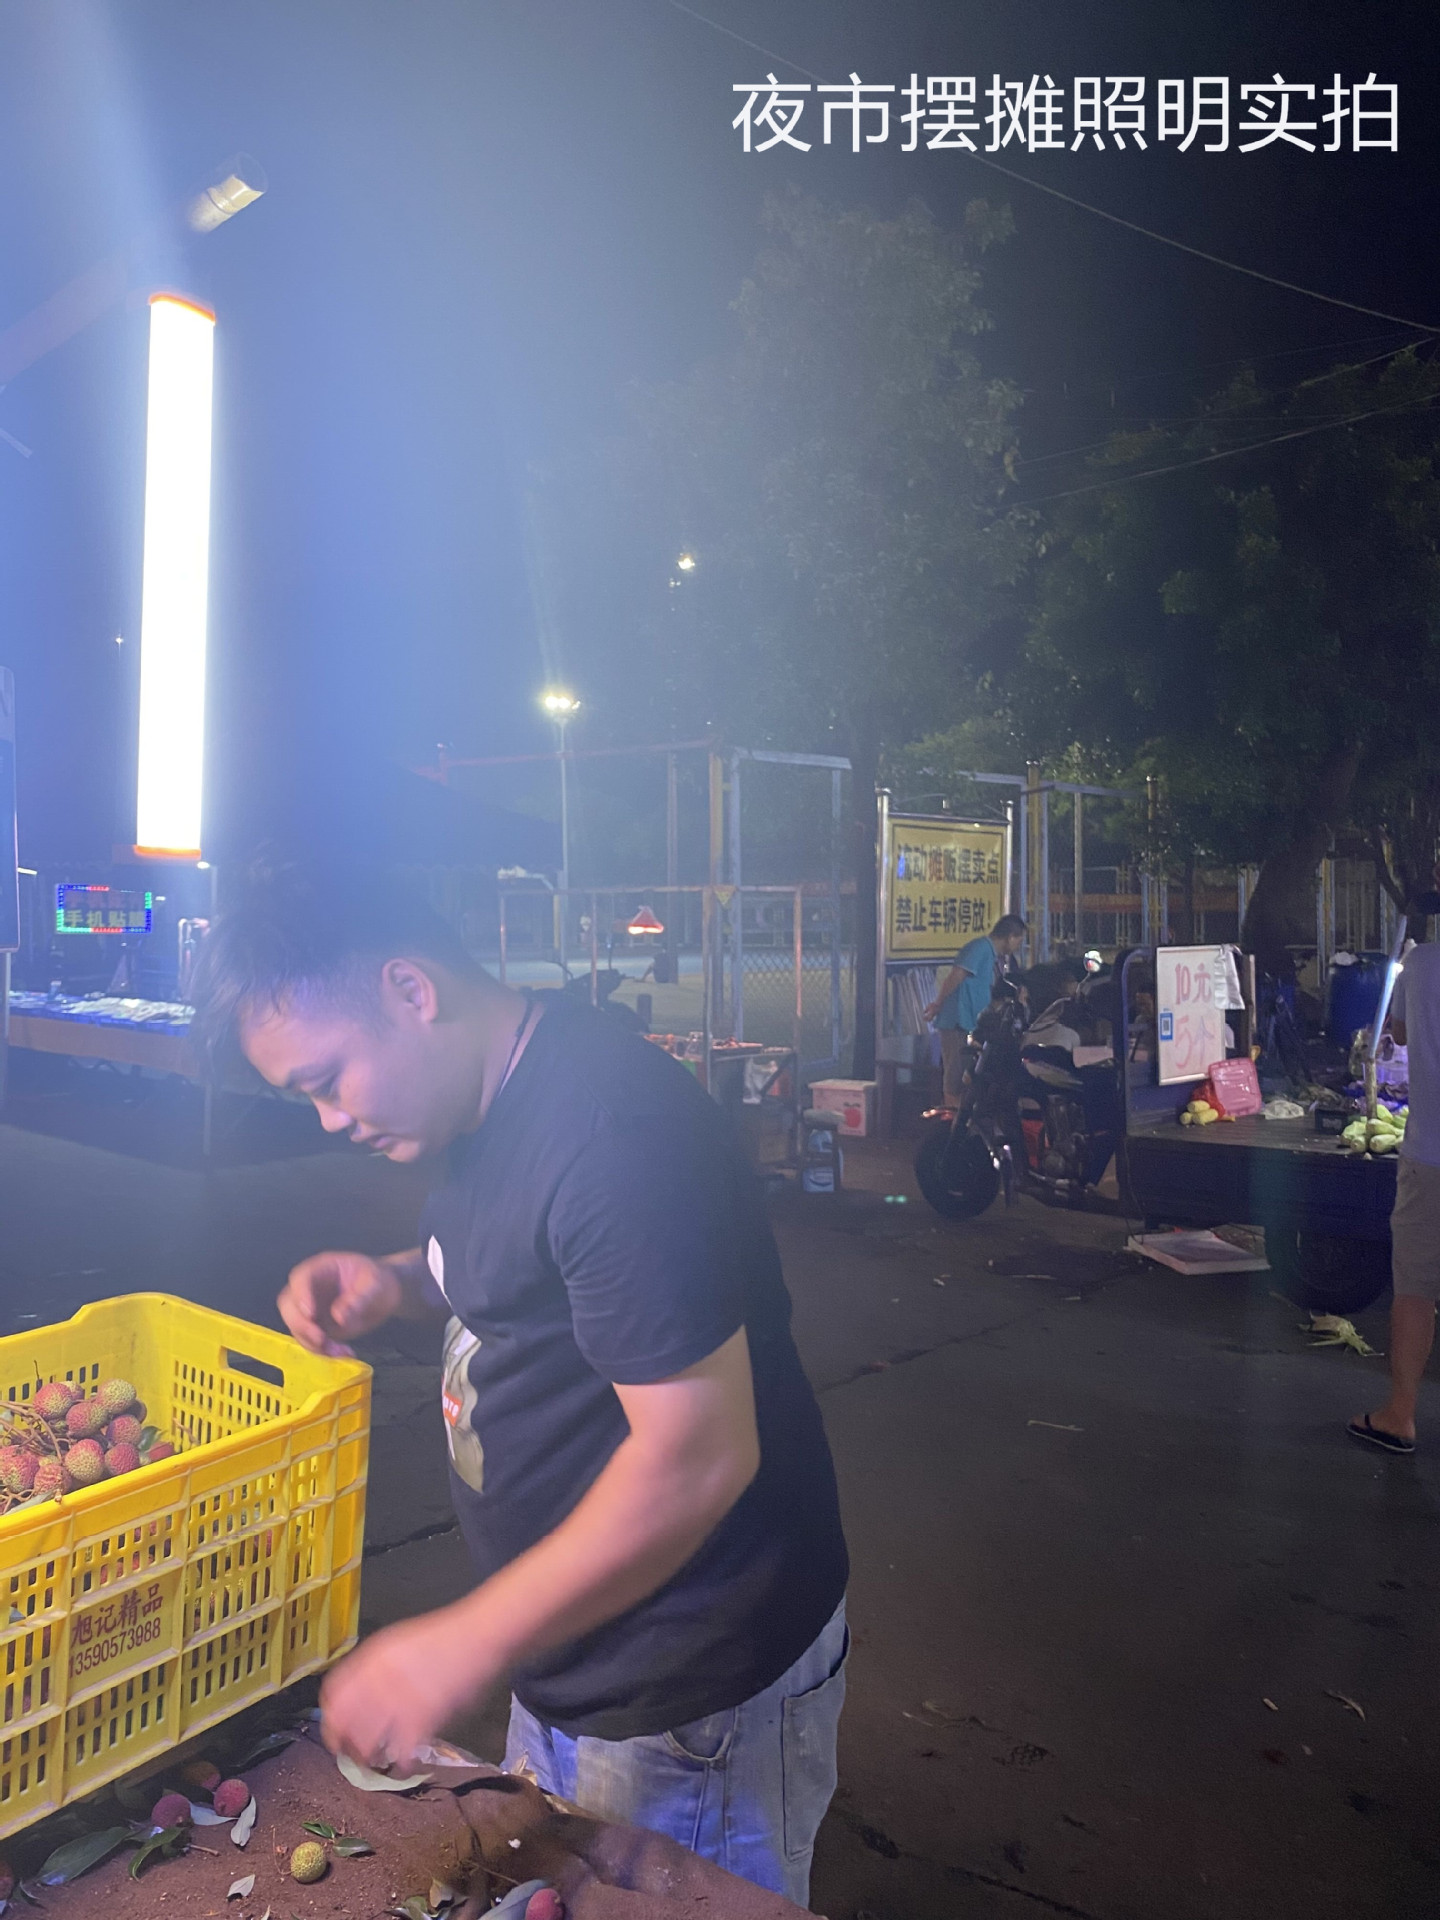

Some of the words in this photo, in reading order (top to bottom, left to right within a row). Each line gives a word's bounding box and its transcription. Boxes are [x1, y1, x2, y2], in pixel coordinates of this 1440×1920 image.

[1174, 963, 1212, 1005] 10元
[1174, 1015, 1215, 1069] 5个
[70, 1583, 163, 1648] 旭记精品
[69, 1617, 161, 1678] 13590573988
